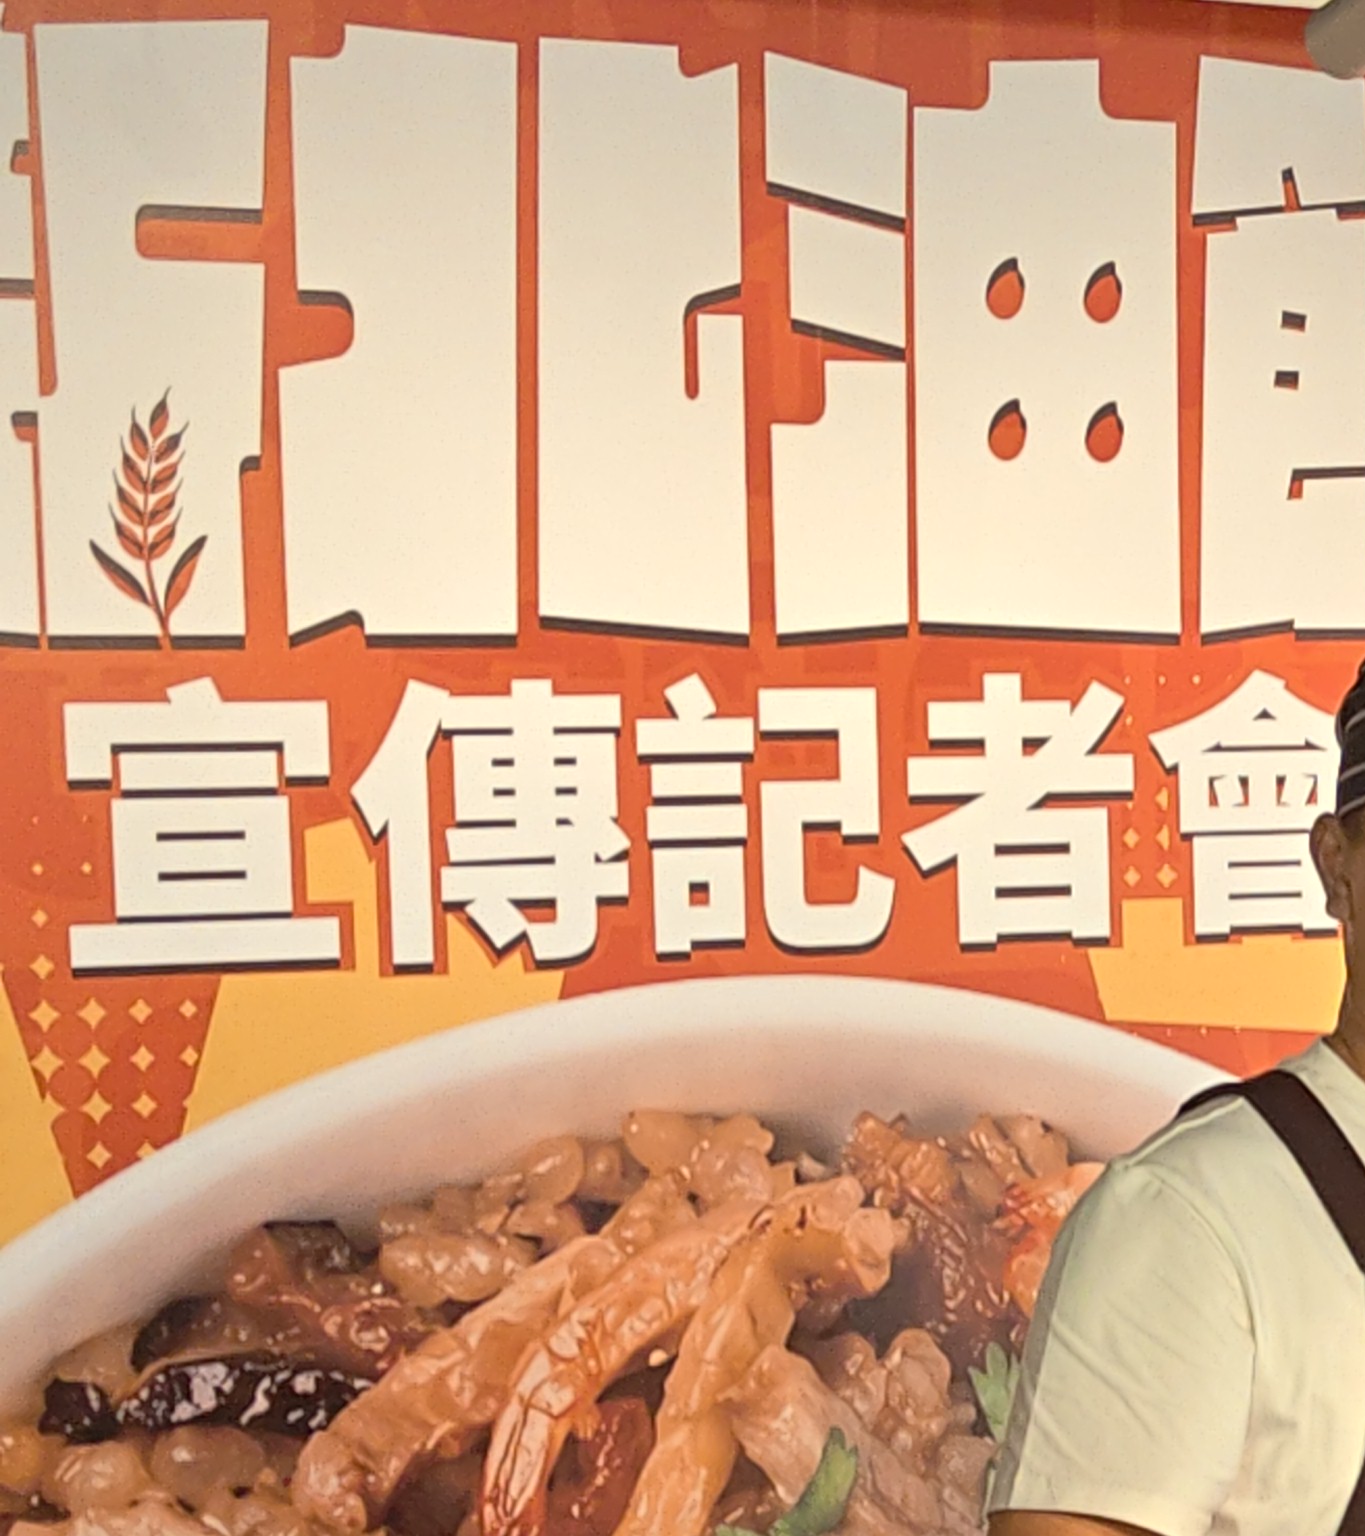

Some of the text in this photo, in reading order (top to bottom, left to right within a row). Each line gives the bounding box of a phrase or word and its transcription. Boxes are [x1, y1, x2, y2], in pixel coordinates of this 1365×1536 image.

[64, 669, 1341, 977] 宣傳記者會
